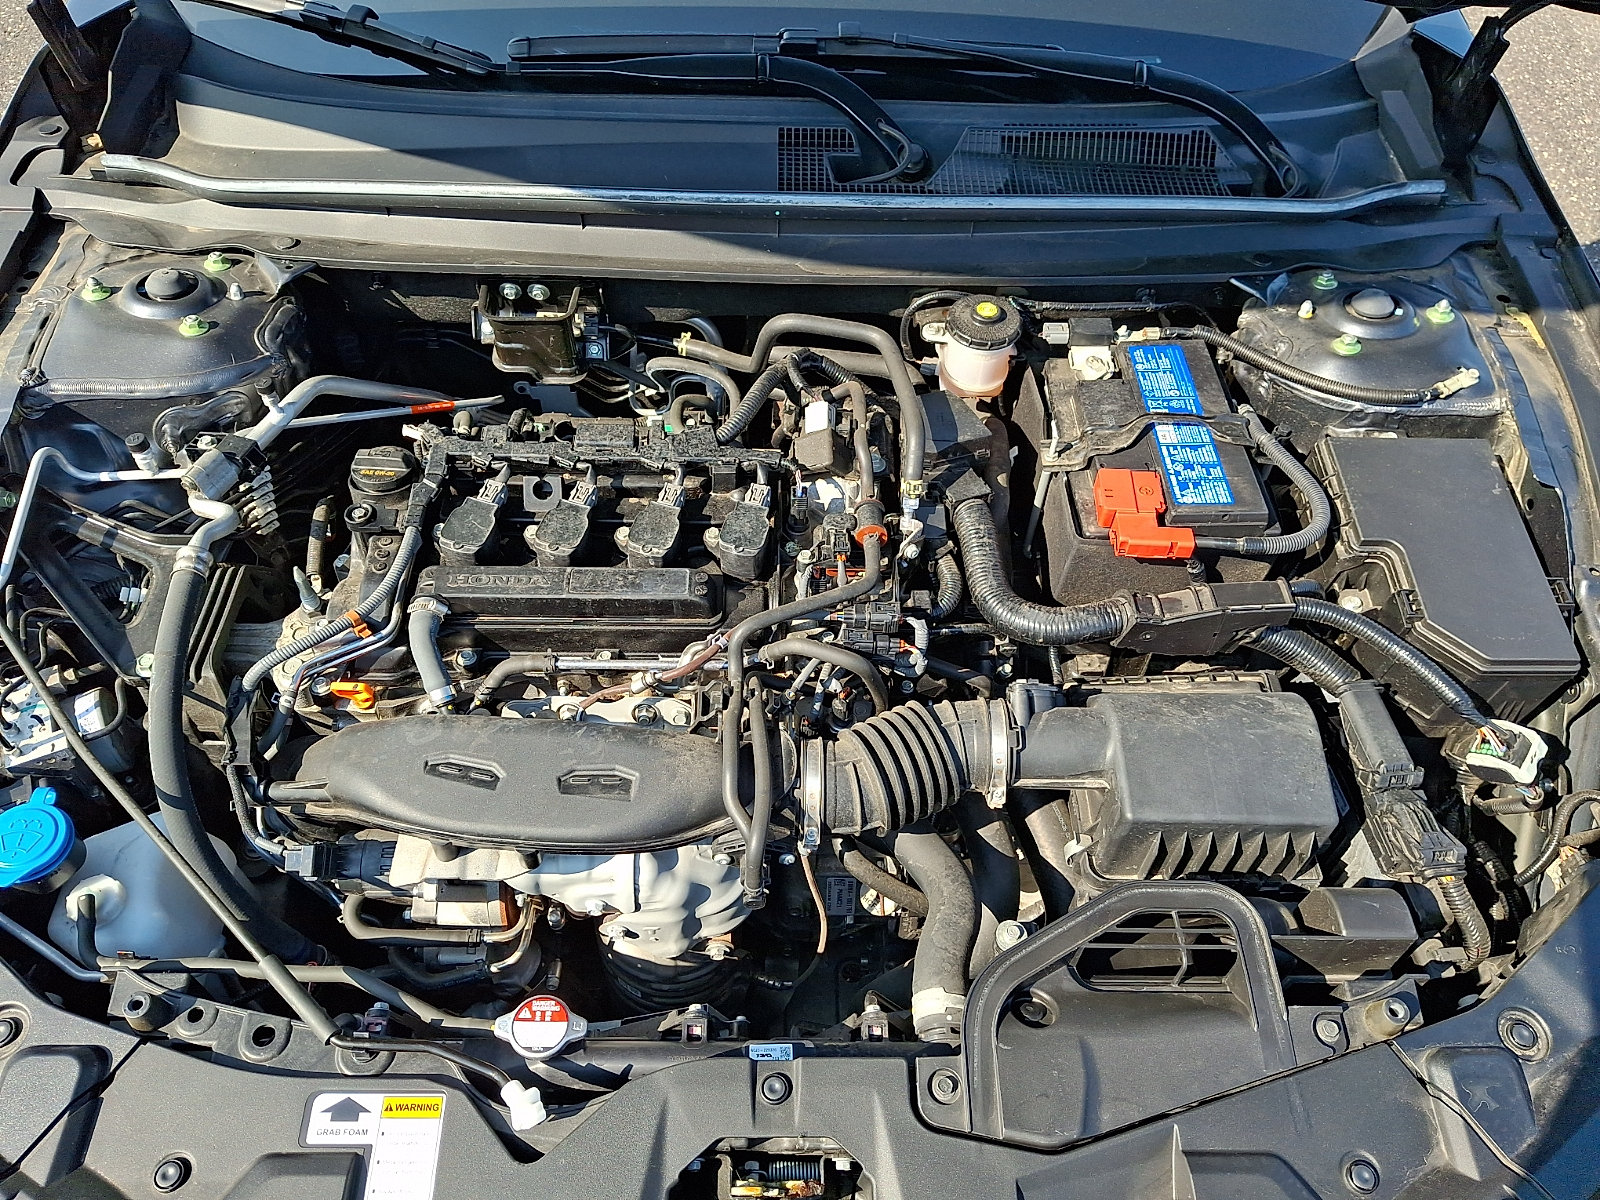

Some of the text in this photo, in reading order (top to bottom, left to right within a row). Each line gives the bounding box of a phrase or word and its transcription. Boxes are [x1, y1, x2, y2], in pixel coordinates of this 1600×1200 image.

[447, 573, 551, 587] HONDA
[395, 1103, 439, 1112] WARNING
[316, 1128, 368, 1136] GRAB FOAM
